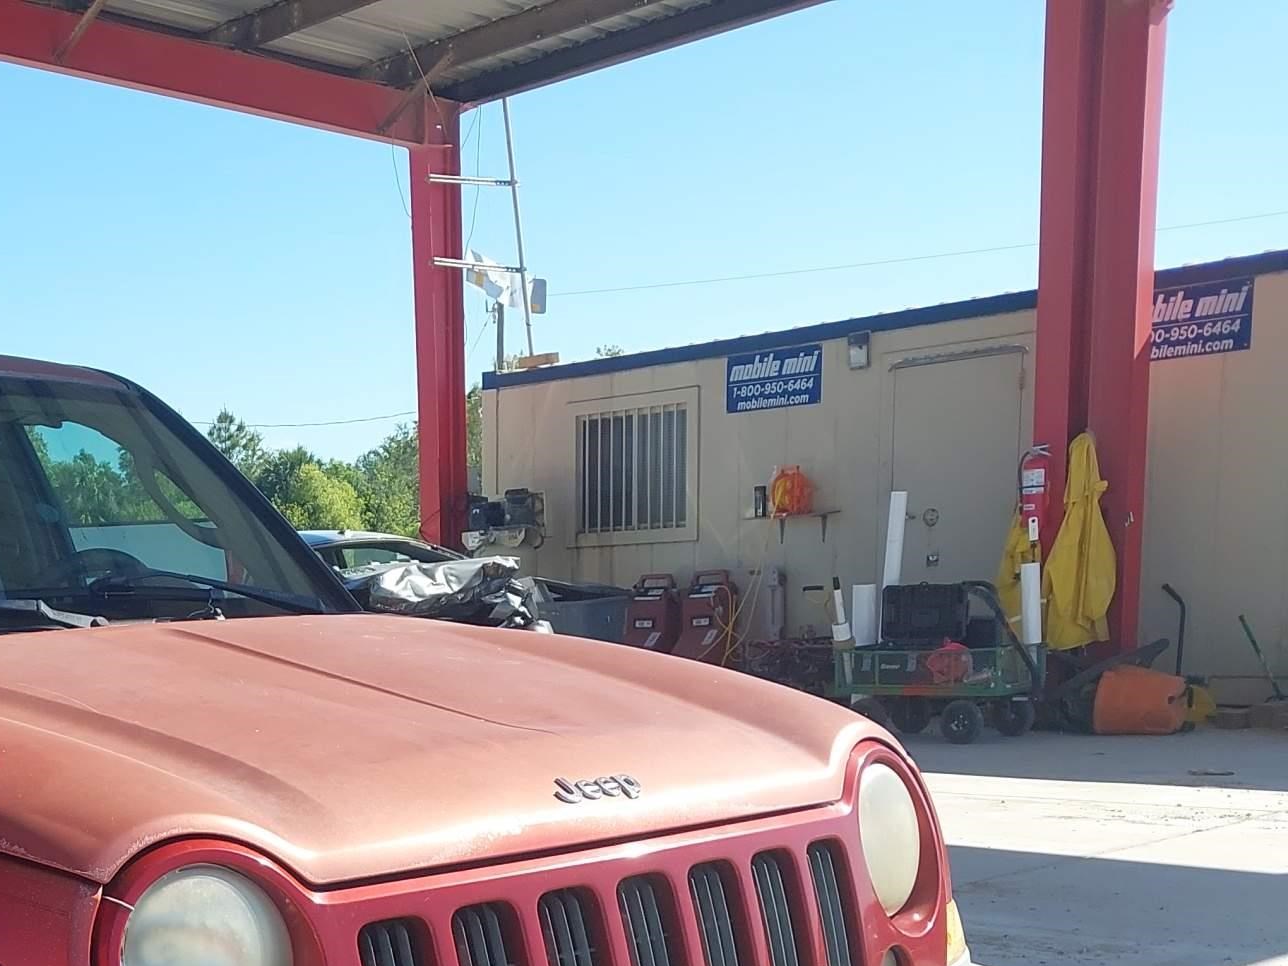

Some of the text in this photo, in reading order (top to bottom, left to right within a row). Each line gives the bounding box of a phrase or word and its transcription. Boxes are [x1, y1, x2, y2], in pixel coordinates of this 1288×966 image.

[1195, 286, 1249, 316] mini
[1150, 338, 1234, 359] bilemini.com
[730, 351, 819, 382] mobile mini
[733, 377, 814, 399] 1-800-950-6464
[737, 393, 809, 411] mobilemini.com
[553, 774, 641, 804] Jeep
